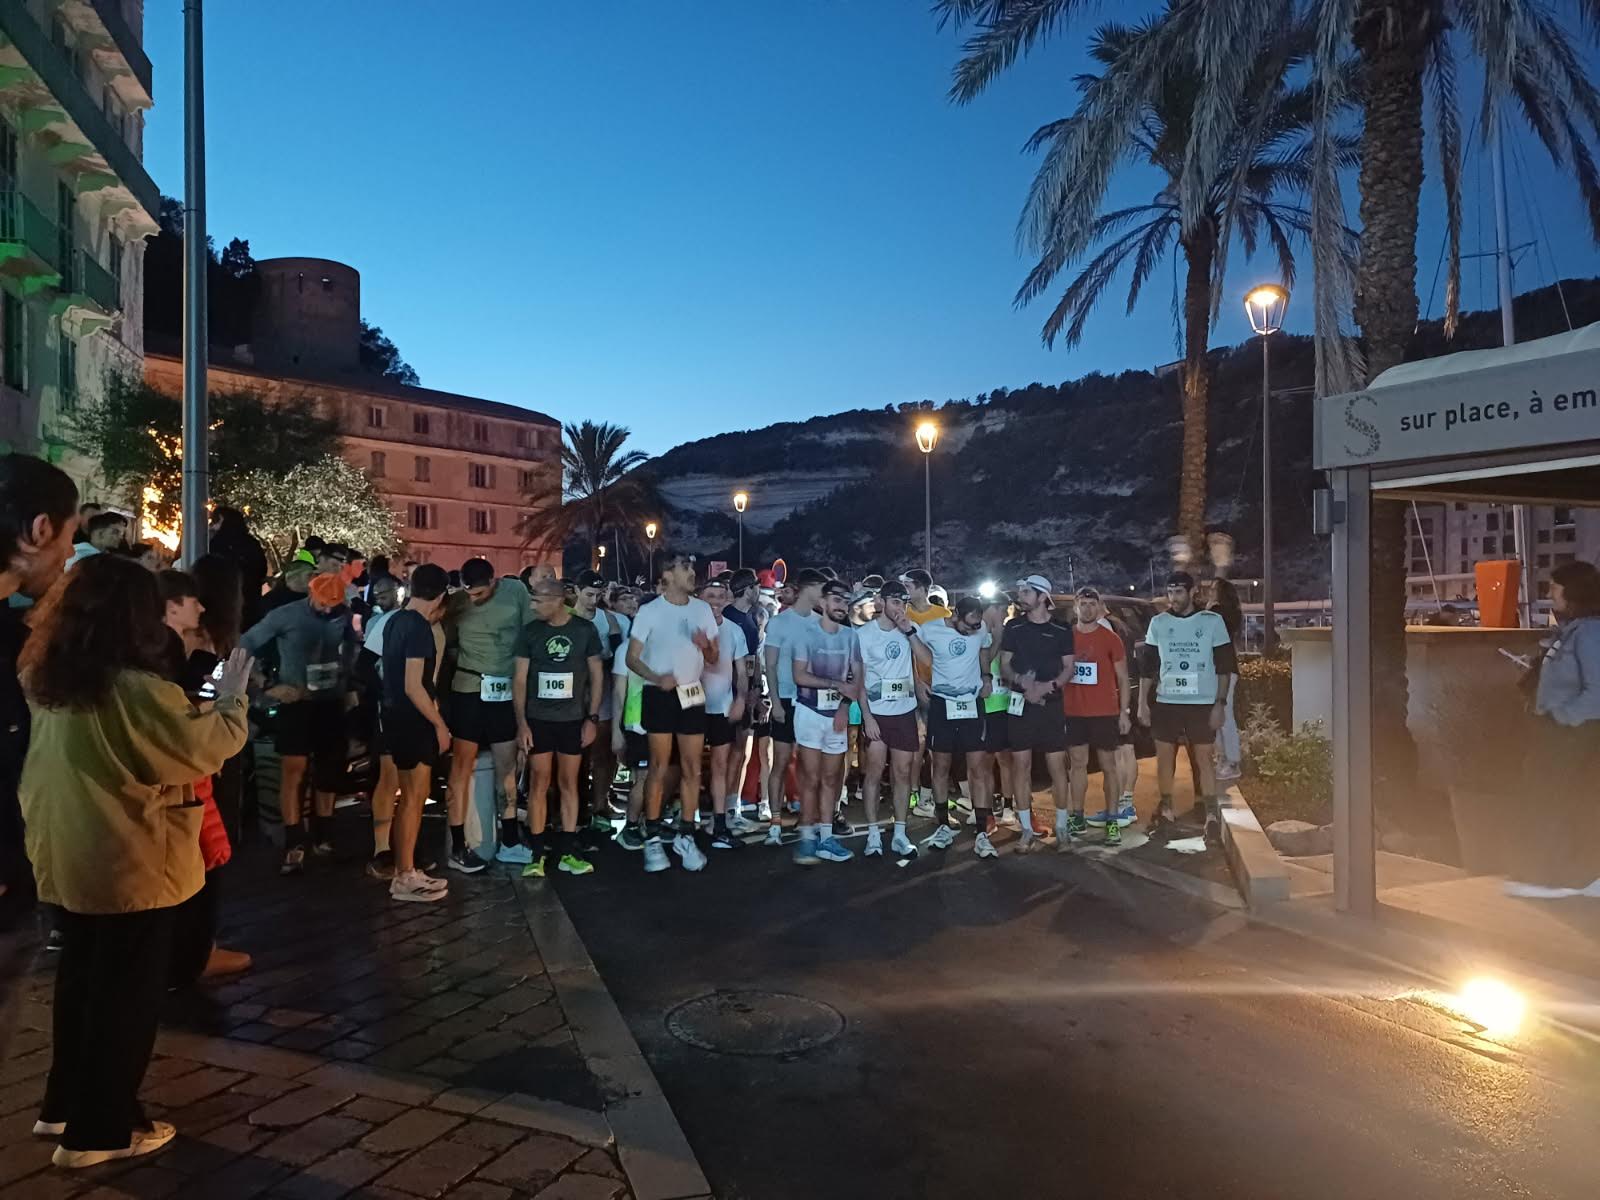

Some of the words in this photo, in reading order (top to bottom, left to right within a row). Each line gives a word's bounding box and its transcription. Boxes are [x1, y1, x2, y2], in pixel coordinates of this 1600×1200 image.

[1400, 411, 1437, 431] sur
[1445, 402, 1520, 430] place,
[1529, 390, 1543, 414] à
[1553, 389, 1597, 411] em
[1344, 395, 1381, 458] S
[1073, 666, 1092, 677] 393
[490, 682, 507, 692] 194
[545, 679, 565, 690] 106
[891, 683, 903, 692] 99
[1175, 678, 1188, 687] 56
[956, 701, 968, 711] 55
